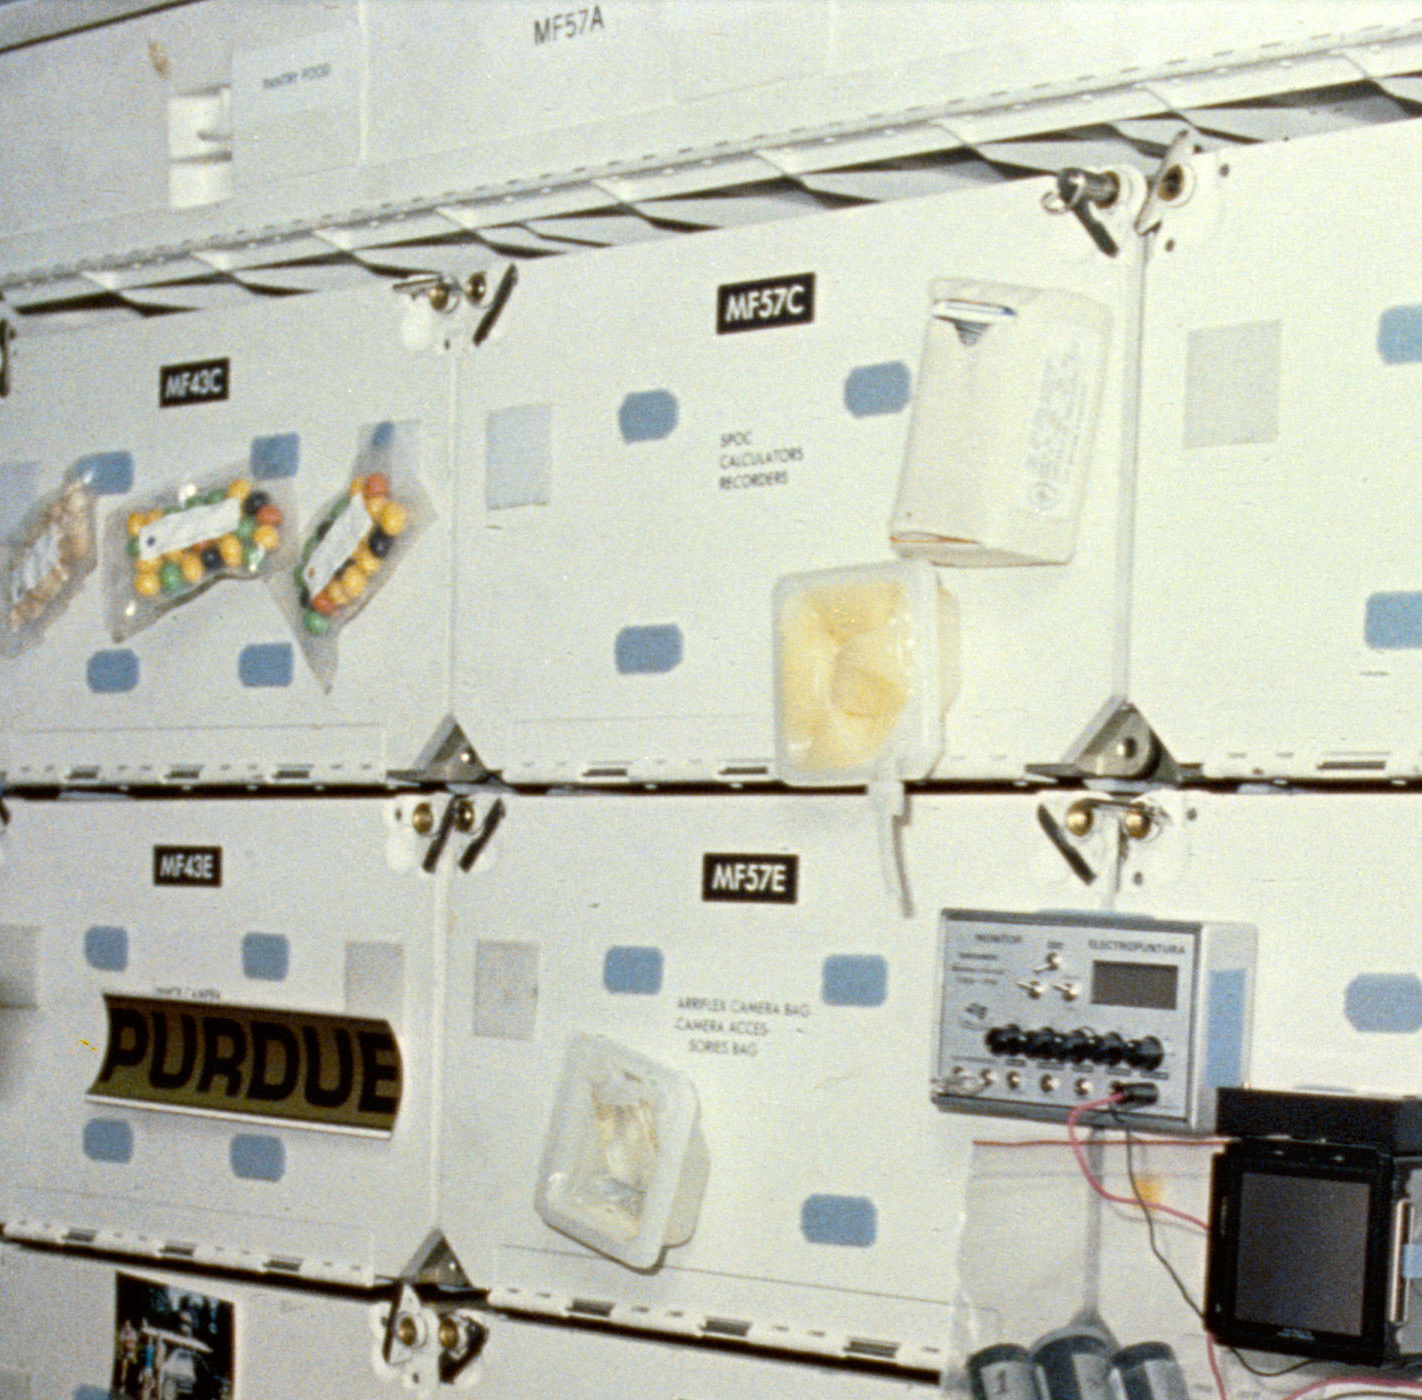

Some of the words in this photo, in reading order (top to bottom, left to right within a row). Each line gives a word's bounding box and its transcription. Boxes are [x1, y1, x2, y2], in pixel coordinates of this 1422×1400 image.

[534, 5, 605, 46] MF57A
[725, 284, 805, 323] MF57C
[165, 367, 223, 399] MF43C
[720, 430, 753, 448] SPOC
[719, 447, 804, 470] CALCULATORS
[719, 471, 789, 491] RECORDERS
[159, 853, 214, 879] MF43E
[711, 863, 787, 893] MF57E
[730, 999, 780, 1015] CAMERA
[784, 1003, 812, 1018] BAG
[675, 1016, 724, 1032] CAMERA
[98, 1006, 400, 1115] PURDUE
[732, 1041, 758, 1057] BAG
